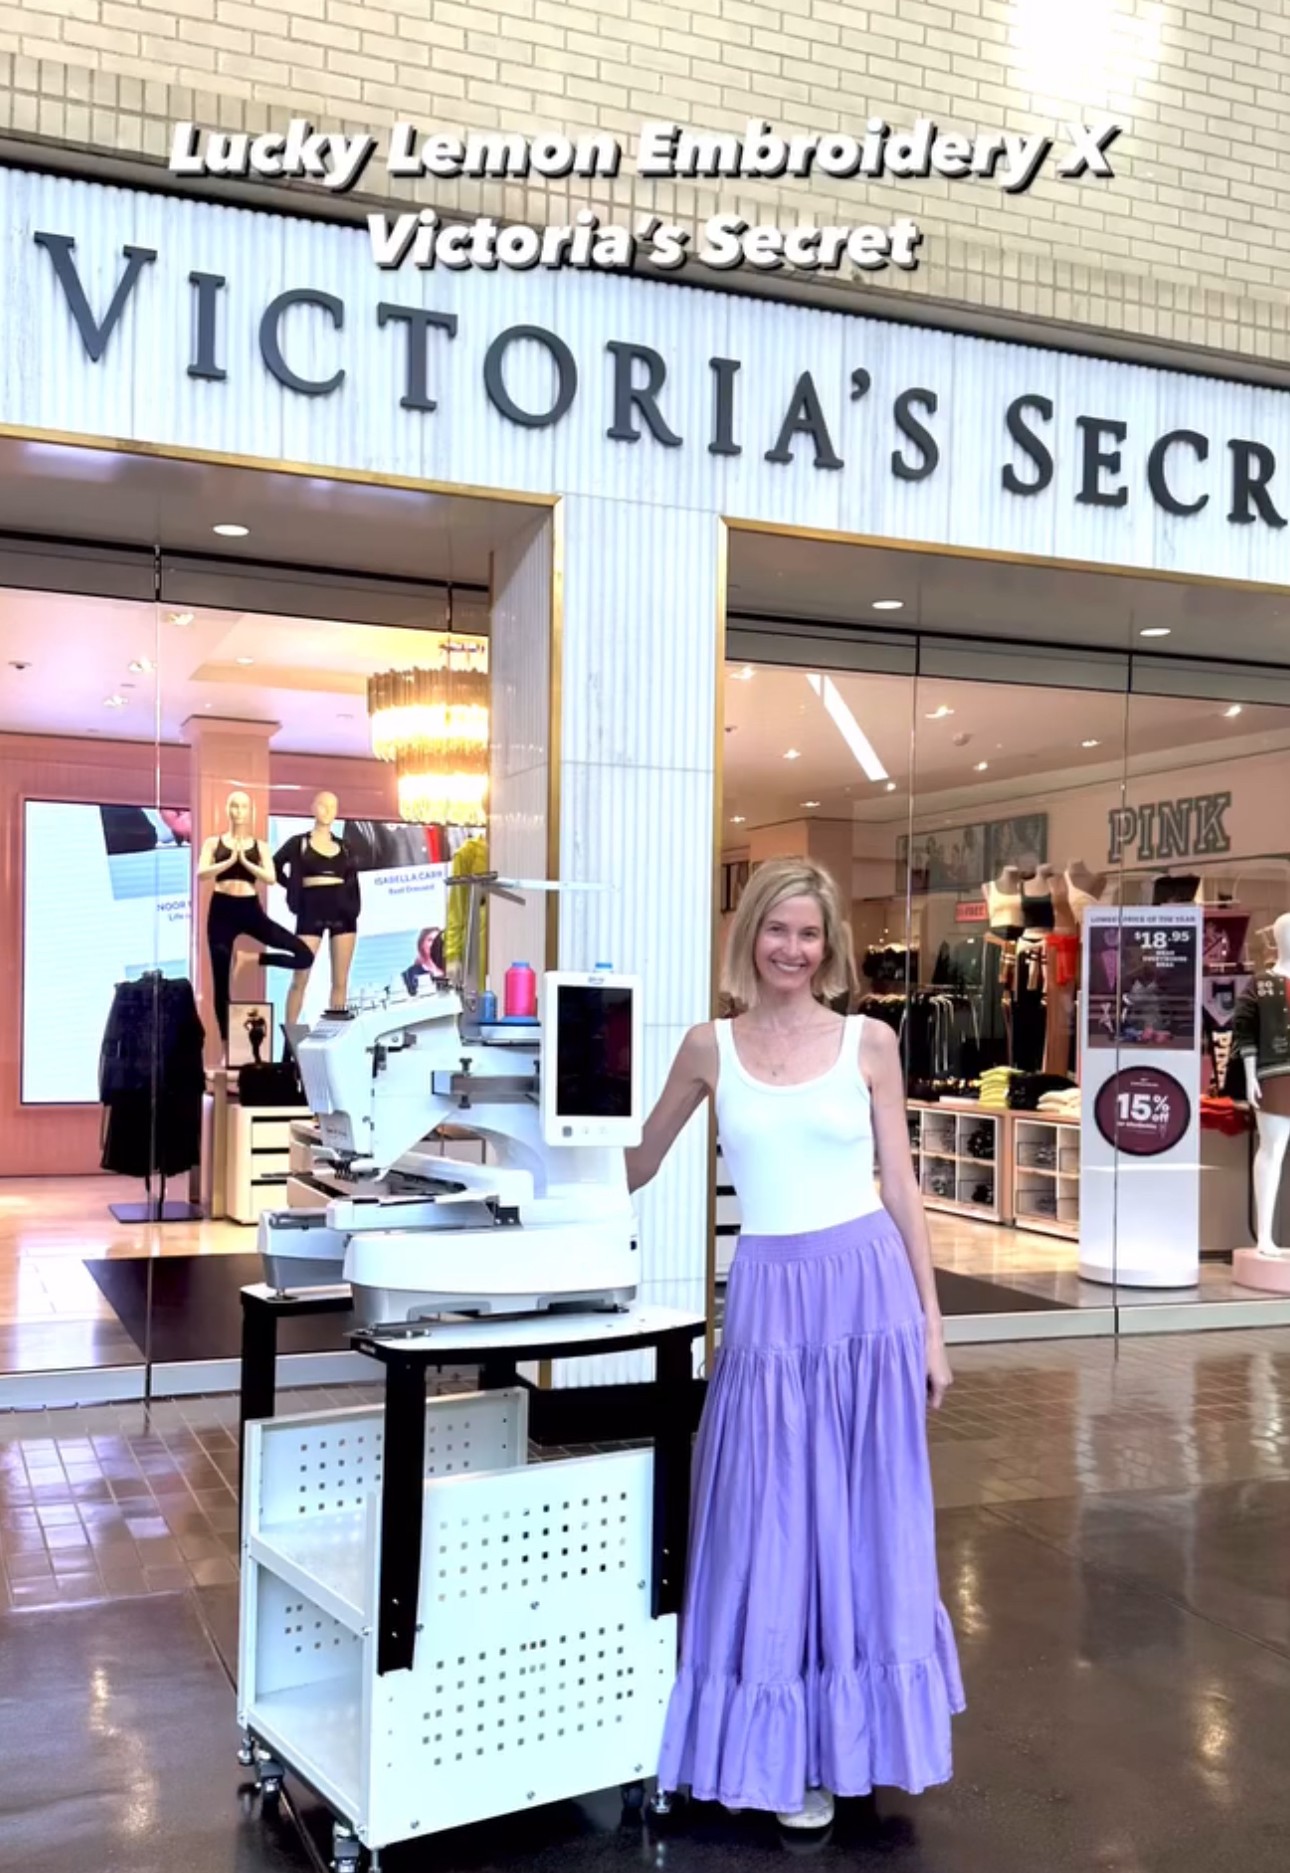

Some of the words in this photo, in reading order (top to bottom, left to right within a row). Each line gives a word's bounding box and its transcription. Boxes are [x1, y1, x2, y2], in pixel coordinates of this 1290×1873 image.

[33, 230, 939, 481] VICTORIA'S
[1001, 394, 1289, 529] SECR
[1108, 791, 1231, 864] PINK
[1117, 1093, 1170, 1121] 15%
[1152, 1112, 1169, 1122] off
